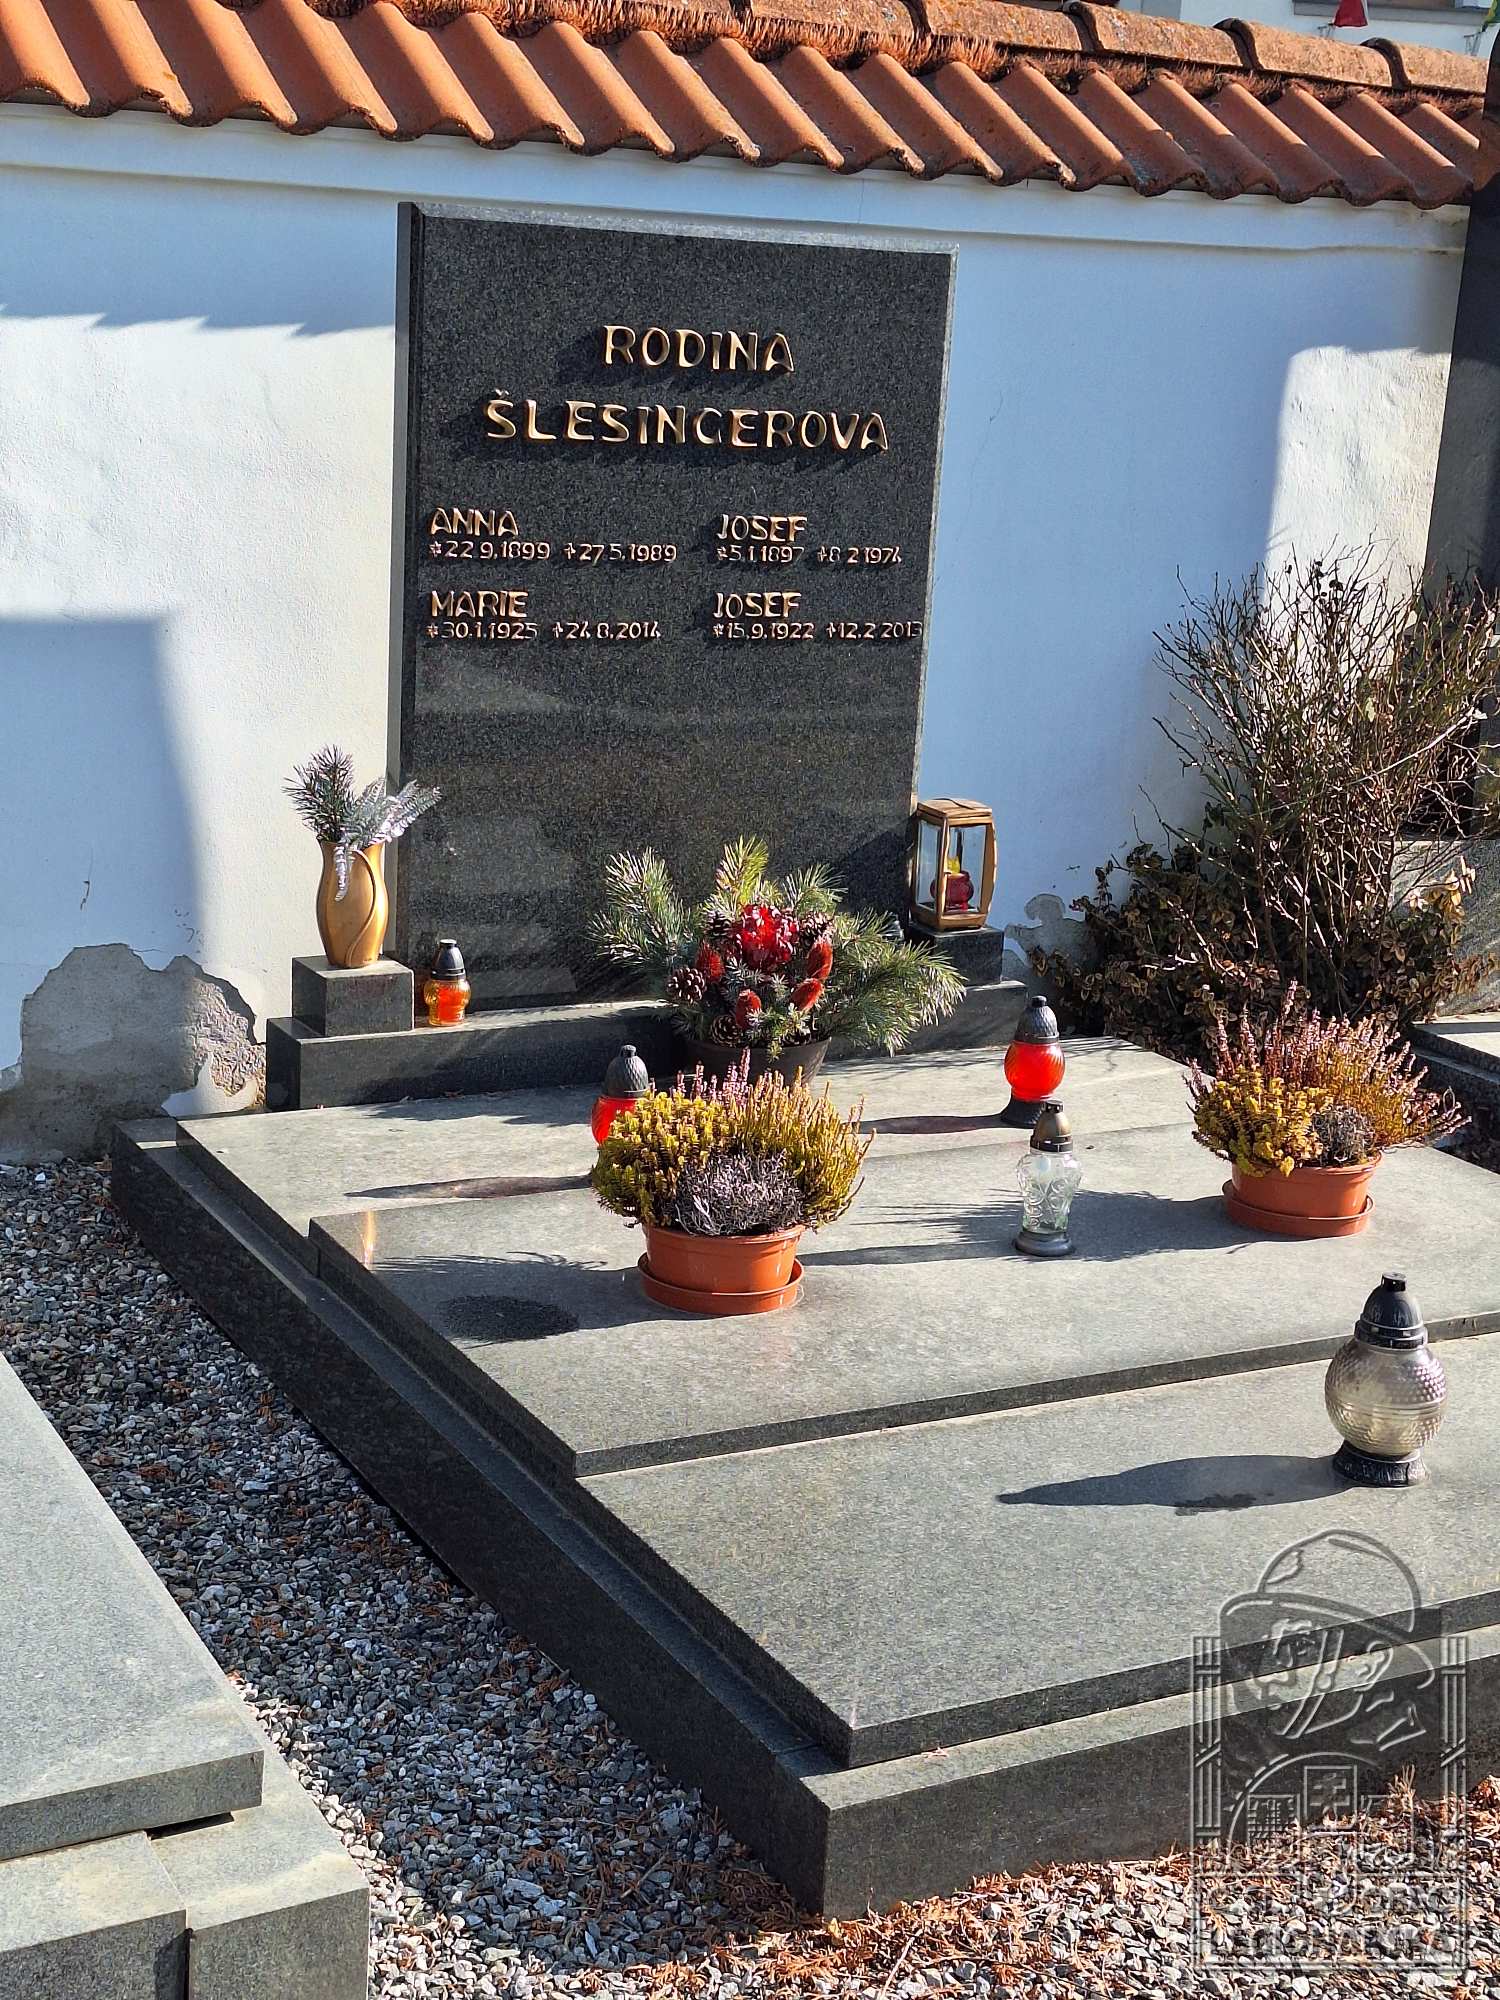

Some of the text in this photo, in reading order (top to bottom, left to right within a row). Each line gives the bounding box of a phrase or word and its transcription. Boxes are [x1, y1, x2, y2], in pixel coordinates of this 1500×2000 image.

[602, 324, 796, 374] RODINA
[430, 507, 519, 537] ANNA
[716, 513, 808, 542] JOSEF
[430, 590, 530, 618] MARIE
[712, 591, 802, 619] JOSEF
